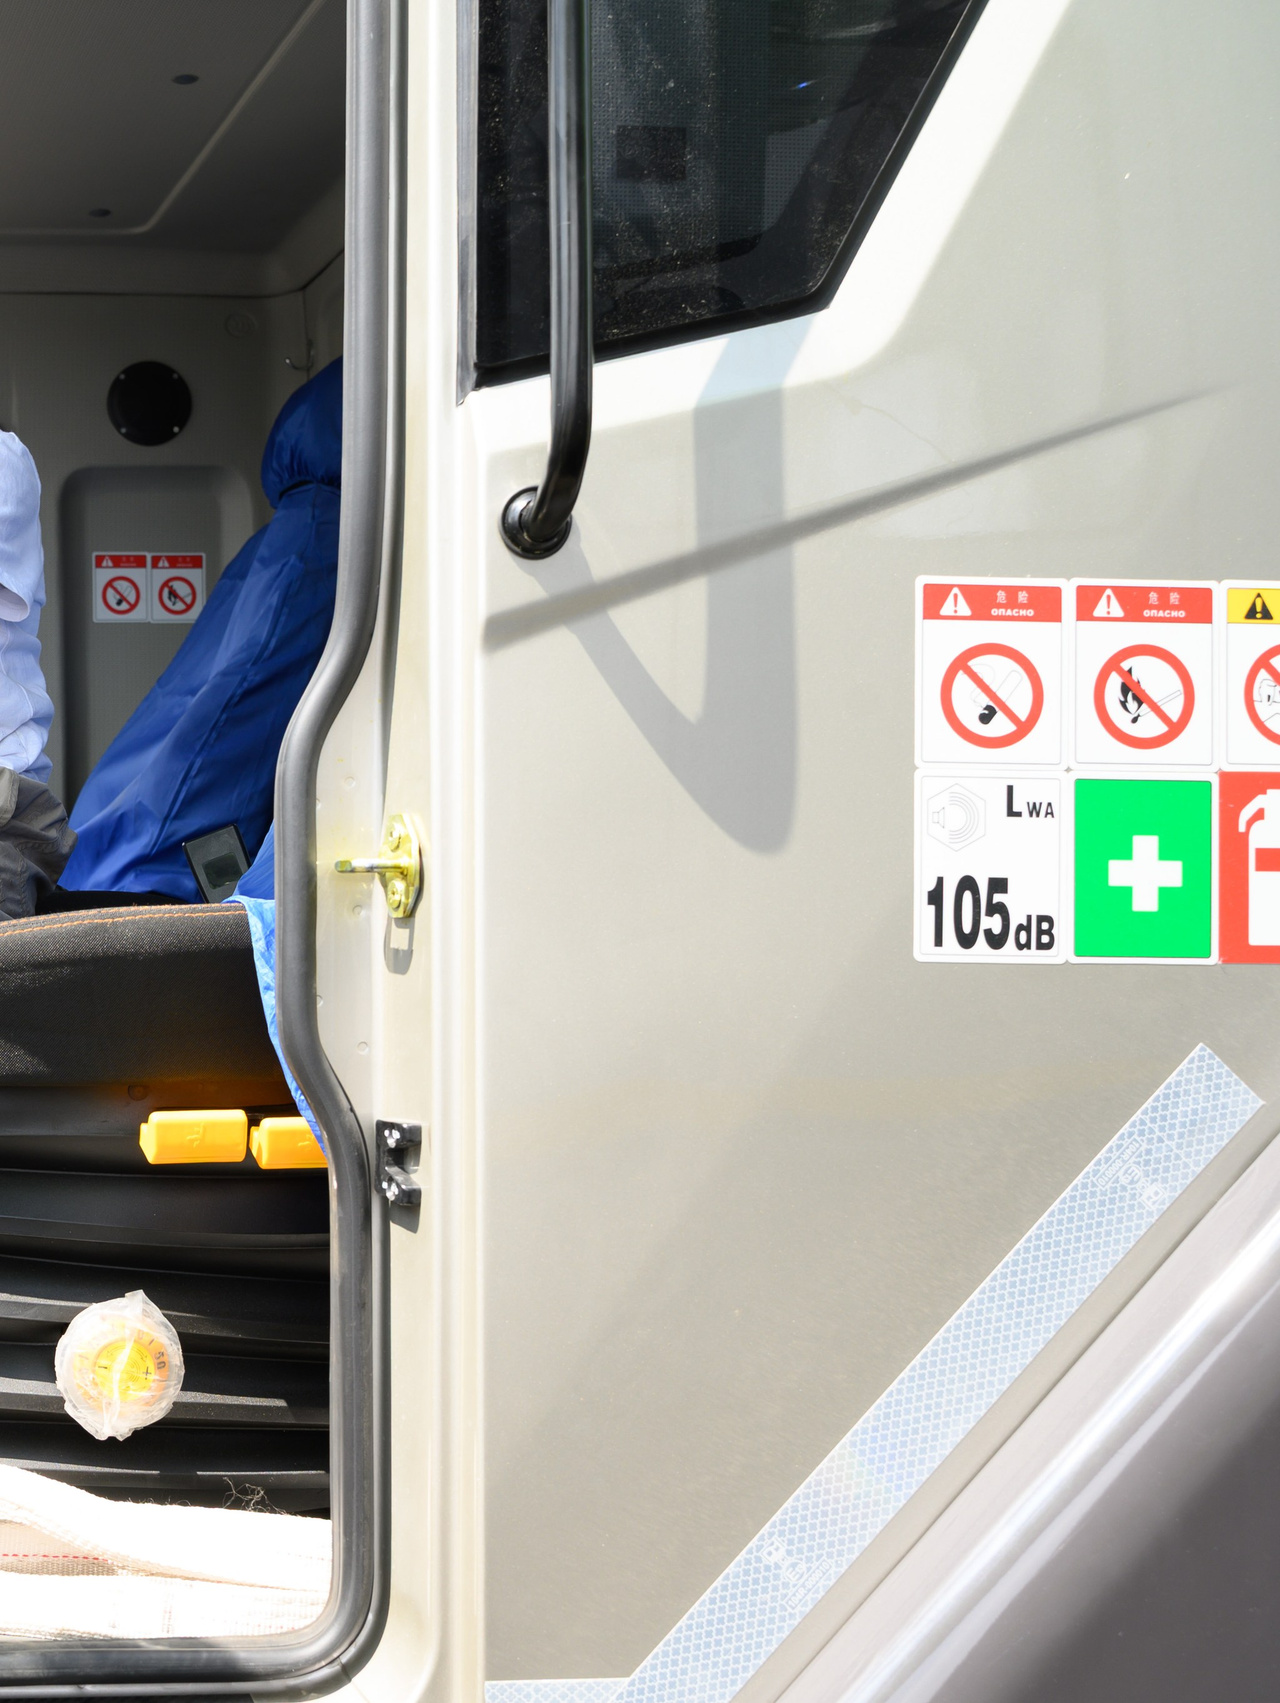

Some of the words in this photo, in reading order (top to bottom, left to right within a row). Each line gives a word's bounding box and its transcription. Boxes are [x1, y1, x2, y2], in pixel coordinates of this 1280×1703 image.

[996, 590, 1029, 604] 危险
[1148, 591, 1180, 606] 危险
[991, 608, 1034, 618] ОПАСНО
[1143, 609, 1186, 619] ОПАСНО
